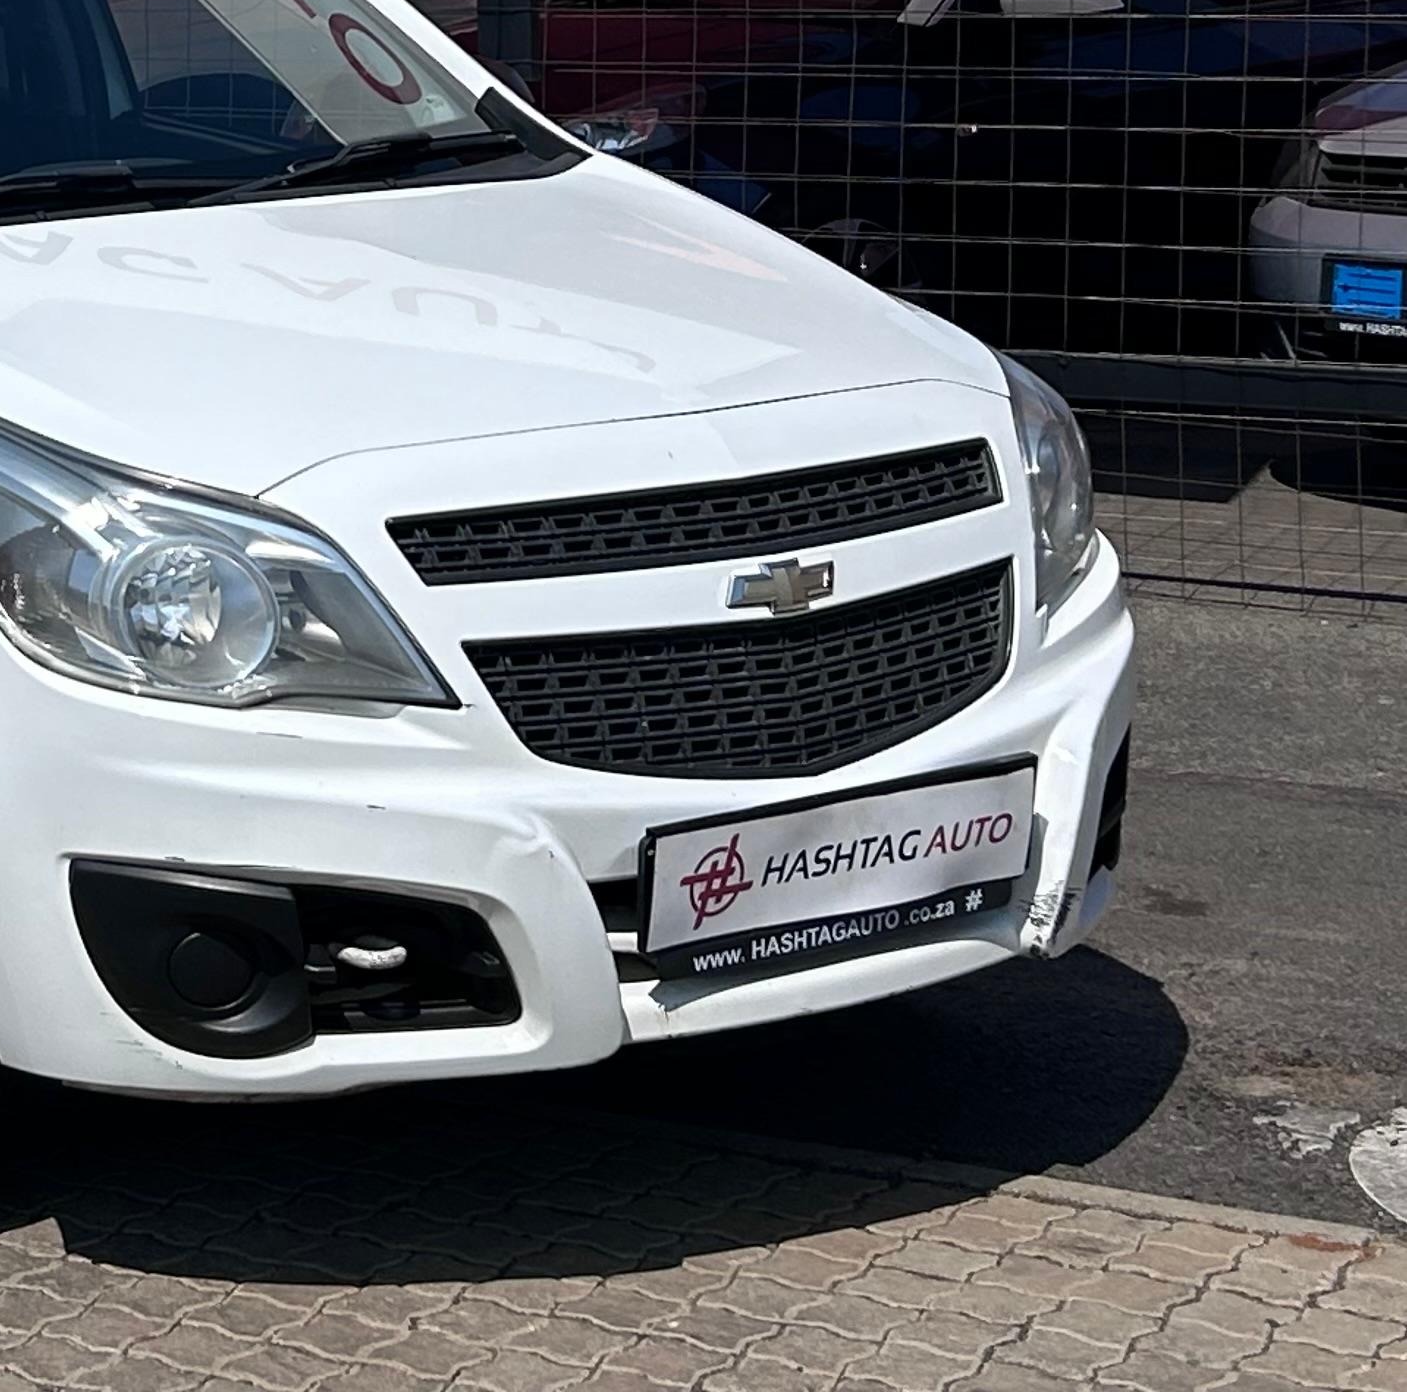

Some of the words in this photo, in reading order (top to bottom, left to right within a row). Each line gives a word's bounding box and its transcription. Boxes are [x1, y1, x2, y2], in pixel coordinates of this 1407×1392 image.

[760, 830, 921, 887] HASHTAG
[923, 813, 1013, 858] AUTO
[751, 910, 900, 960] HASHTAGAUTO
